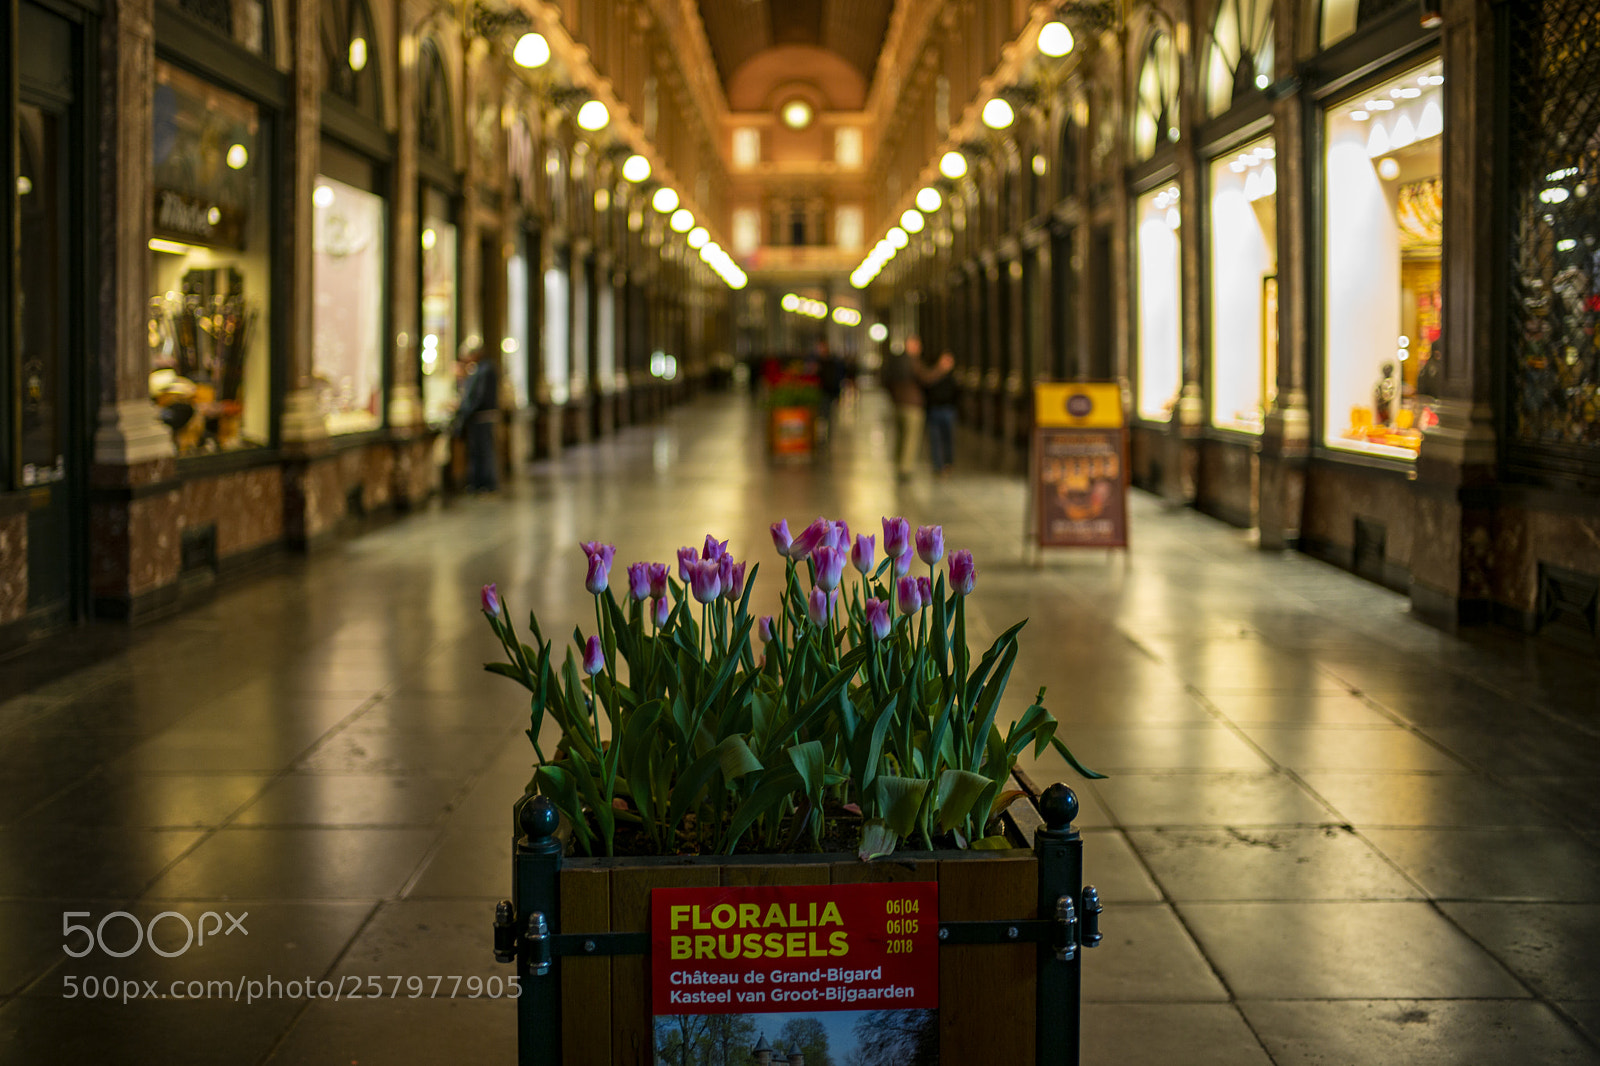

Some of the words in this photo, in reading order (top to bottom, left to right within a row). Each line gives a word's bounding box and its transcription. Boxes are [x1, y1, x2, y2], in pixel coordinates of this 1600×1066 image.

[670, 902, 844, 930] FLORALIA
[670, 932, 849, 960] BRUSSELS
[886, 939, 914, 954] 2018
[670, 969, 740, 985] Château
[743, 970, 766, 984] de
[770, 967, 882, 986] Grand-Bigard
[670, 989, 731, 1004] Kasteel
[736, 990, 766, 1003] van
[770, 985, 915, 1004] Groot-Bijgaarden
